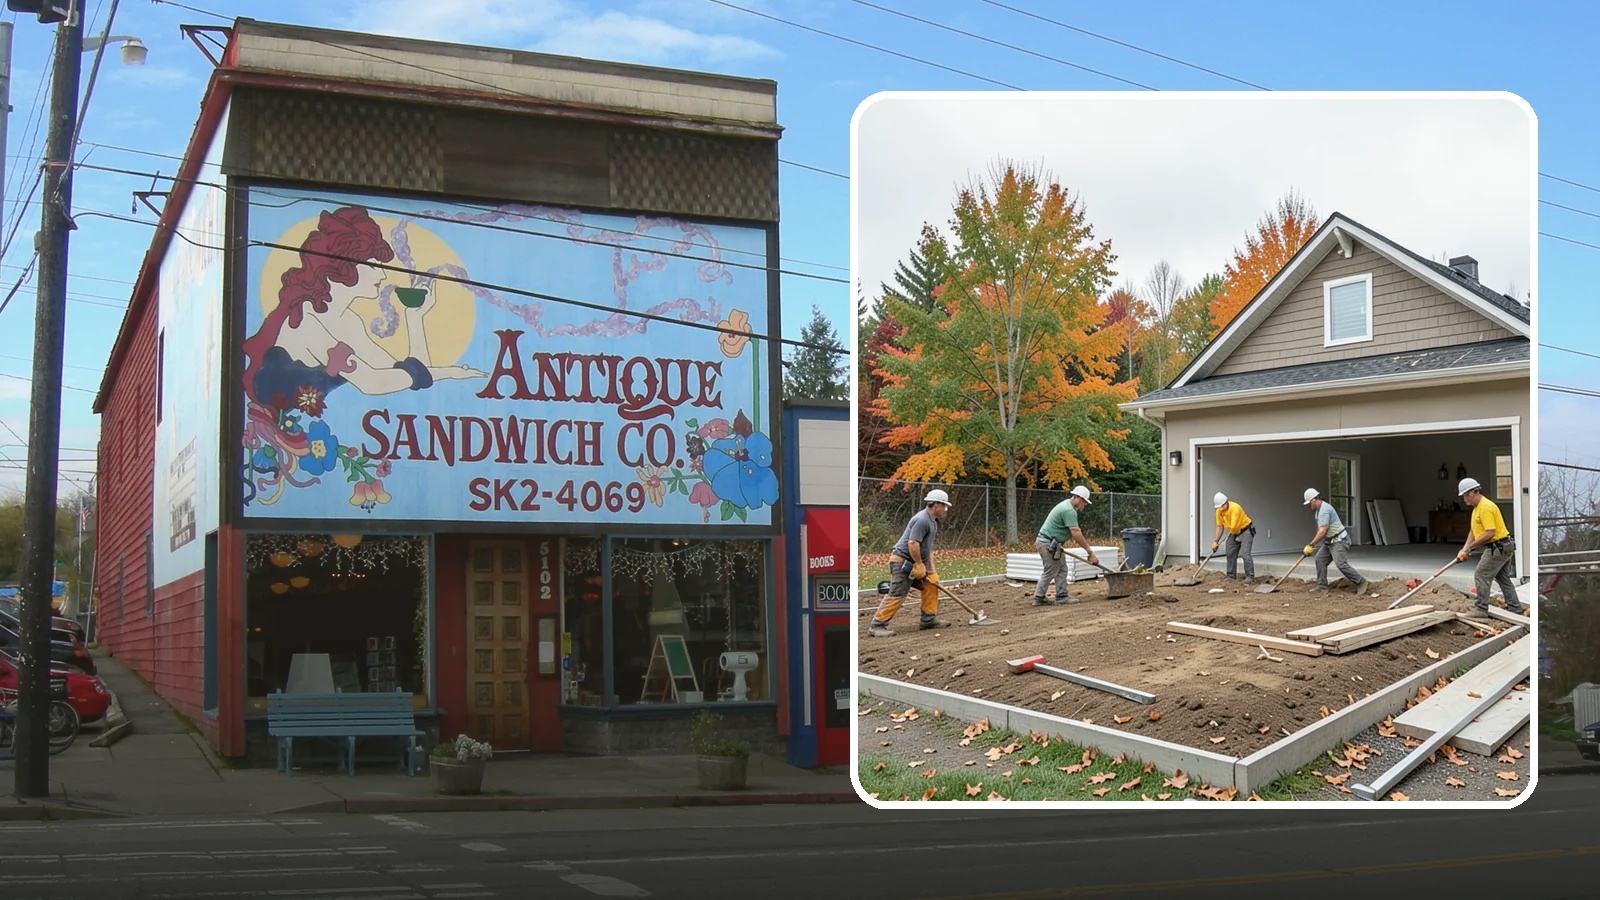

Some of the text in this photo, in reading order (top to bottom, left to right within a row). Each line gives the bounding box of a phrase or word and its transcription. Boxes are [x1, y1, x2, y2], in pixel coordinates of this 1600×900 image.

[475, 329, 723, 421] ANTIQUE
[361, 408, 685, 469] SANDWICH CO.
[468, 477, 646, 513] SK2-4069
[540, 541, 551, 600] 5102
[809, 555, 835, 569] BOOKS
